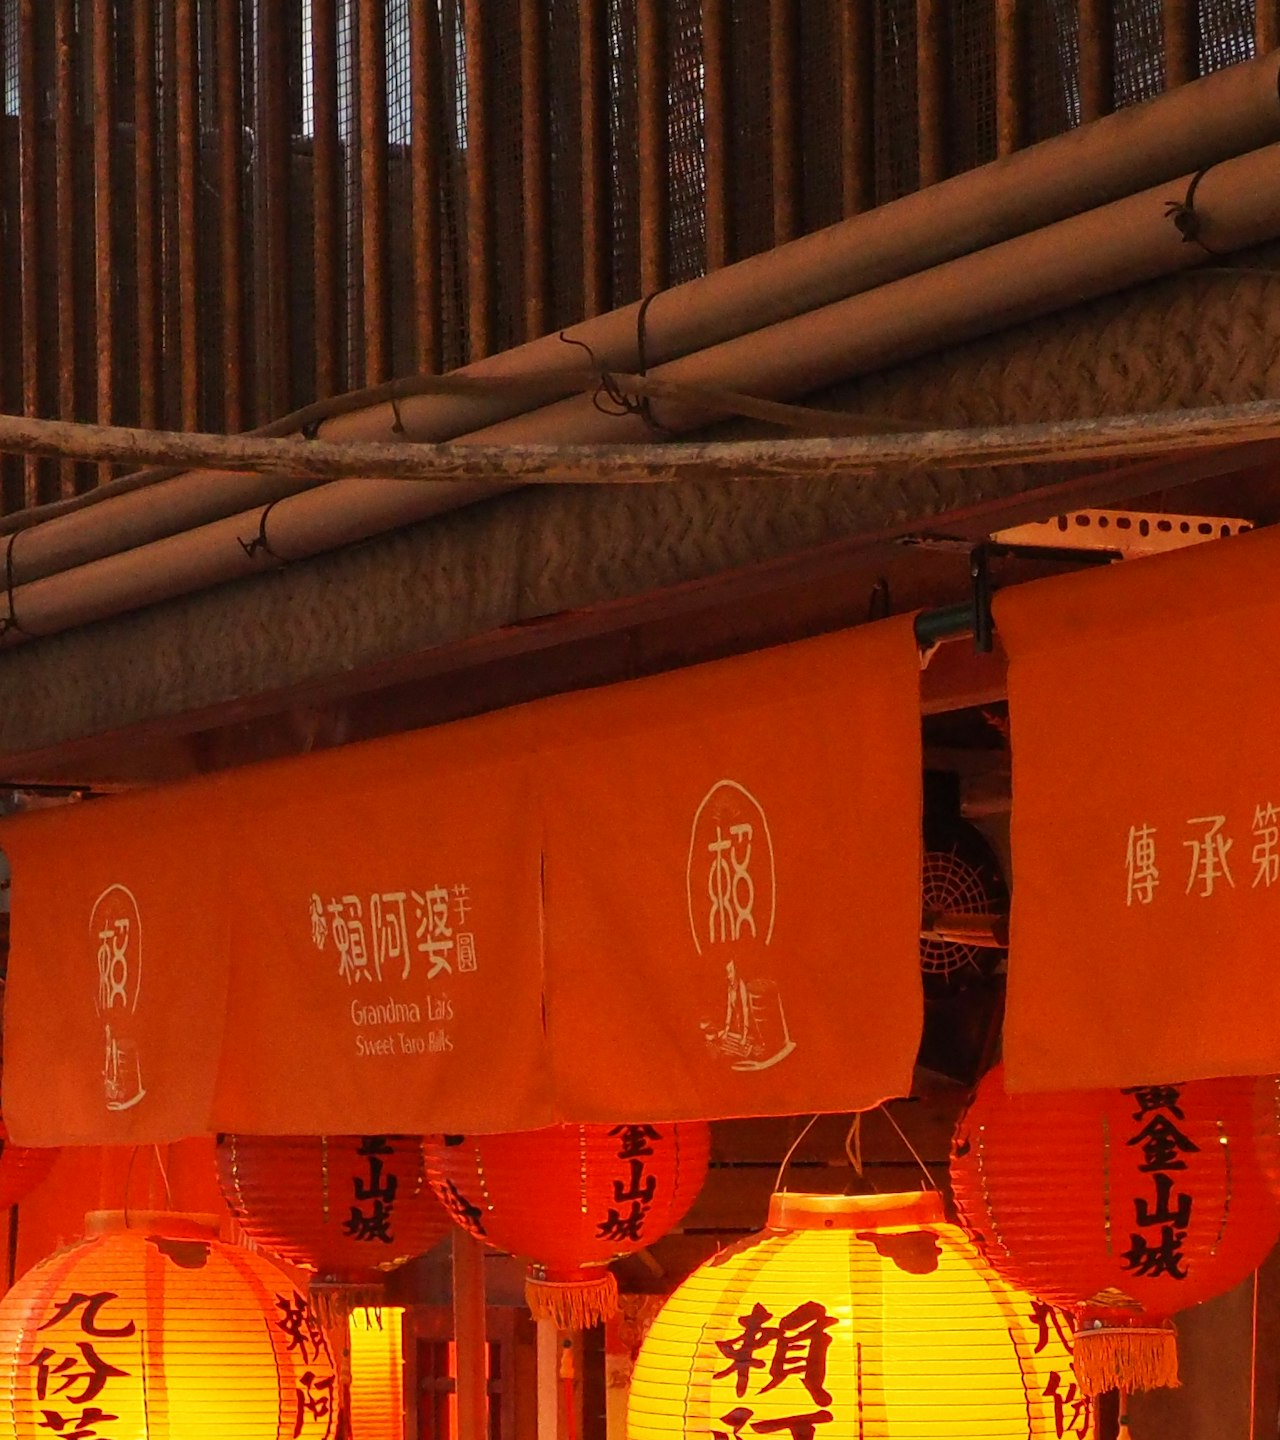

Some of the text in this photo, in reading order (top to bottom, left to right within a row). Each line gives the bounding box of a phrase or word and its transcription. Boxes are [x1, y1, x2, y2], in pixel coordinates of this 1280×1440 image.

[327, 884, 453, 986] 賴阿婆
[451, 883, 477, 973] 芋圓
[351, 996, 420, 1026] Grandma
[356, 1034, 394, 1057] Sweet
[398, 1032, 425, 1054] Taro
